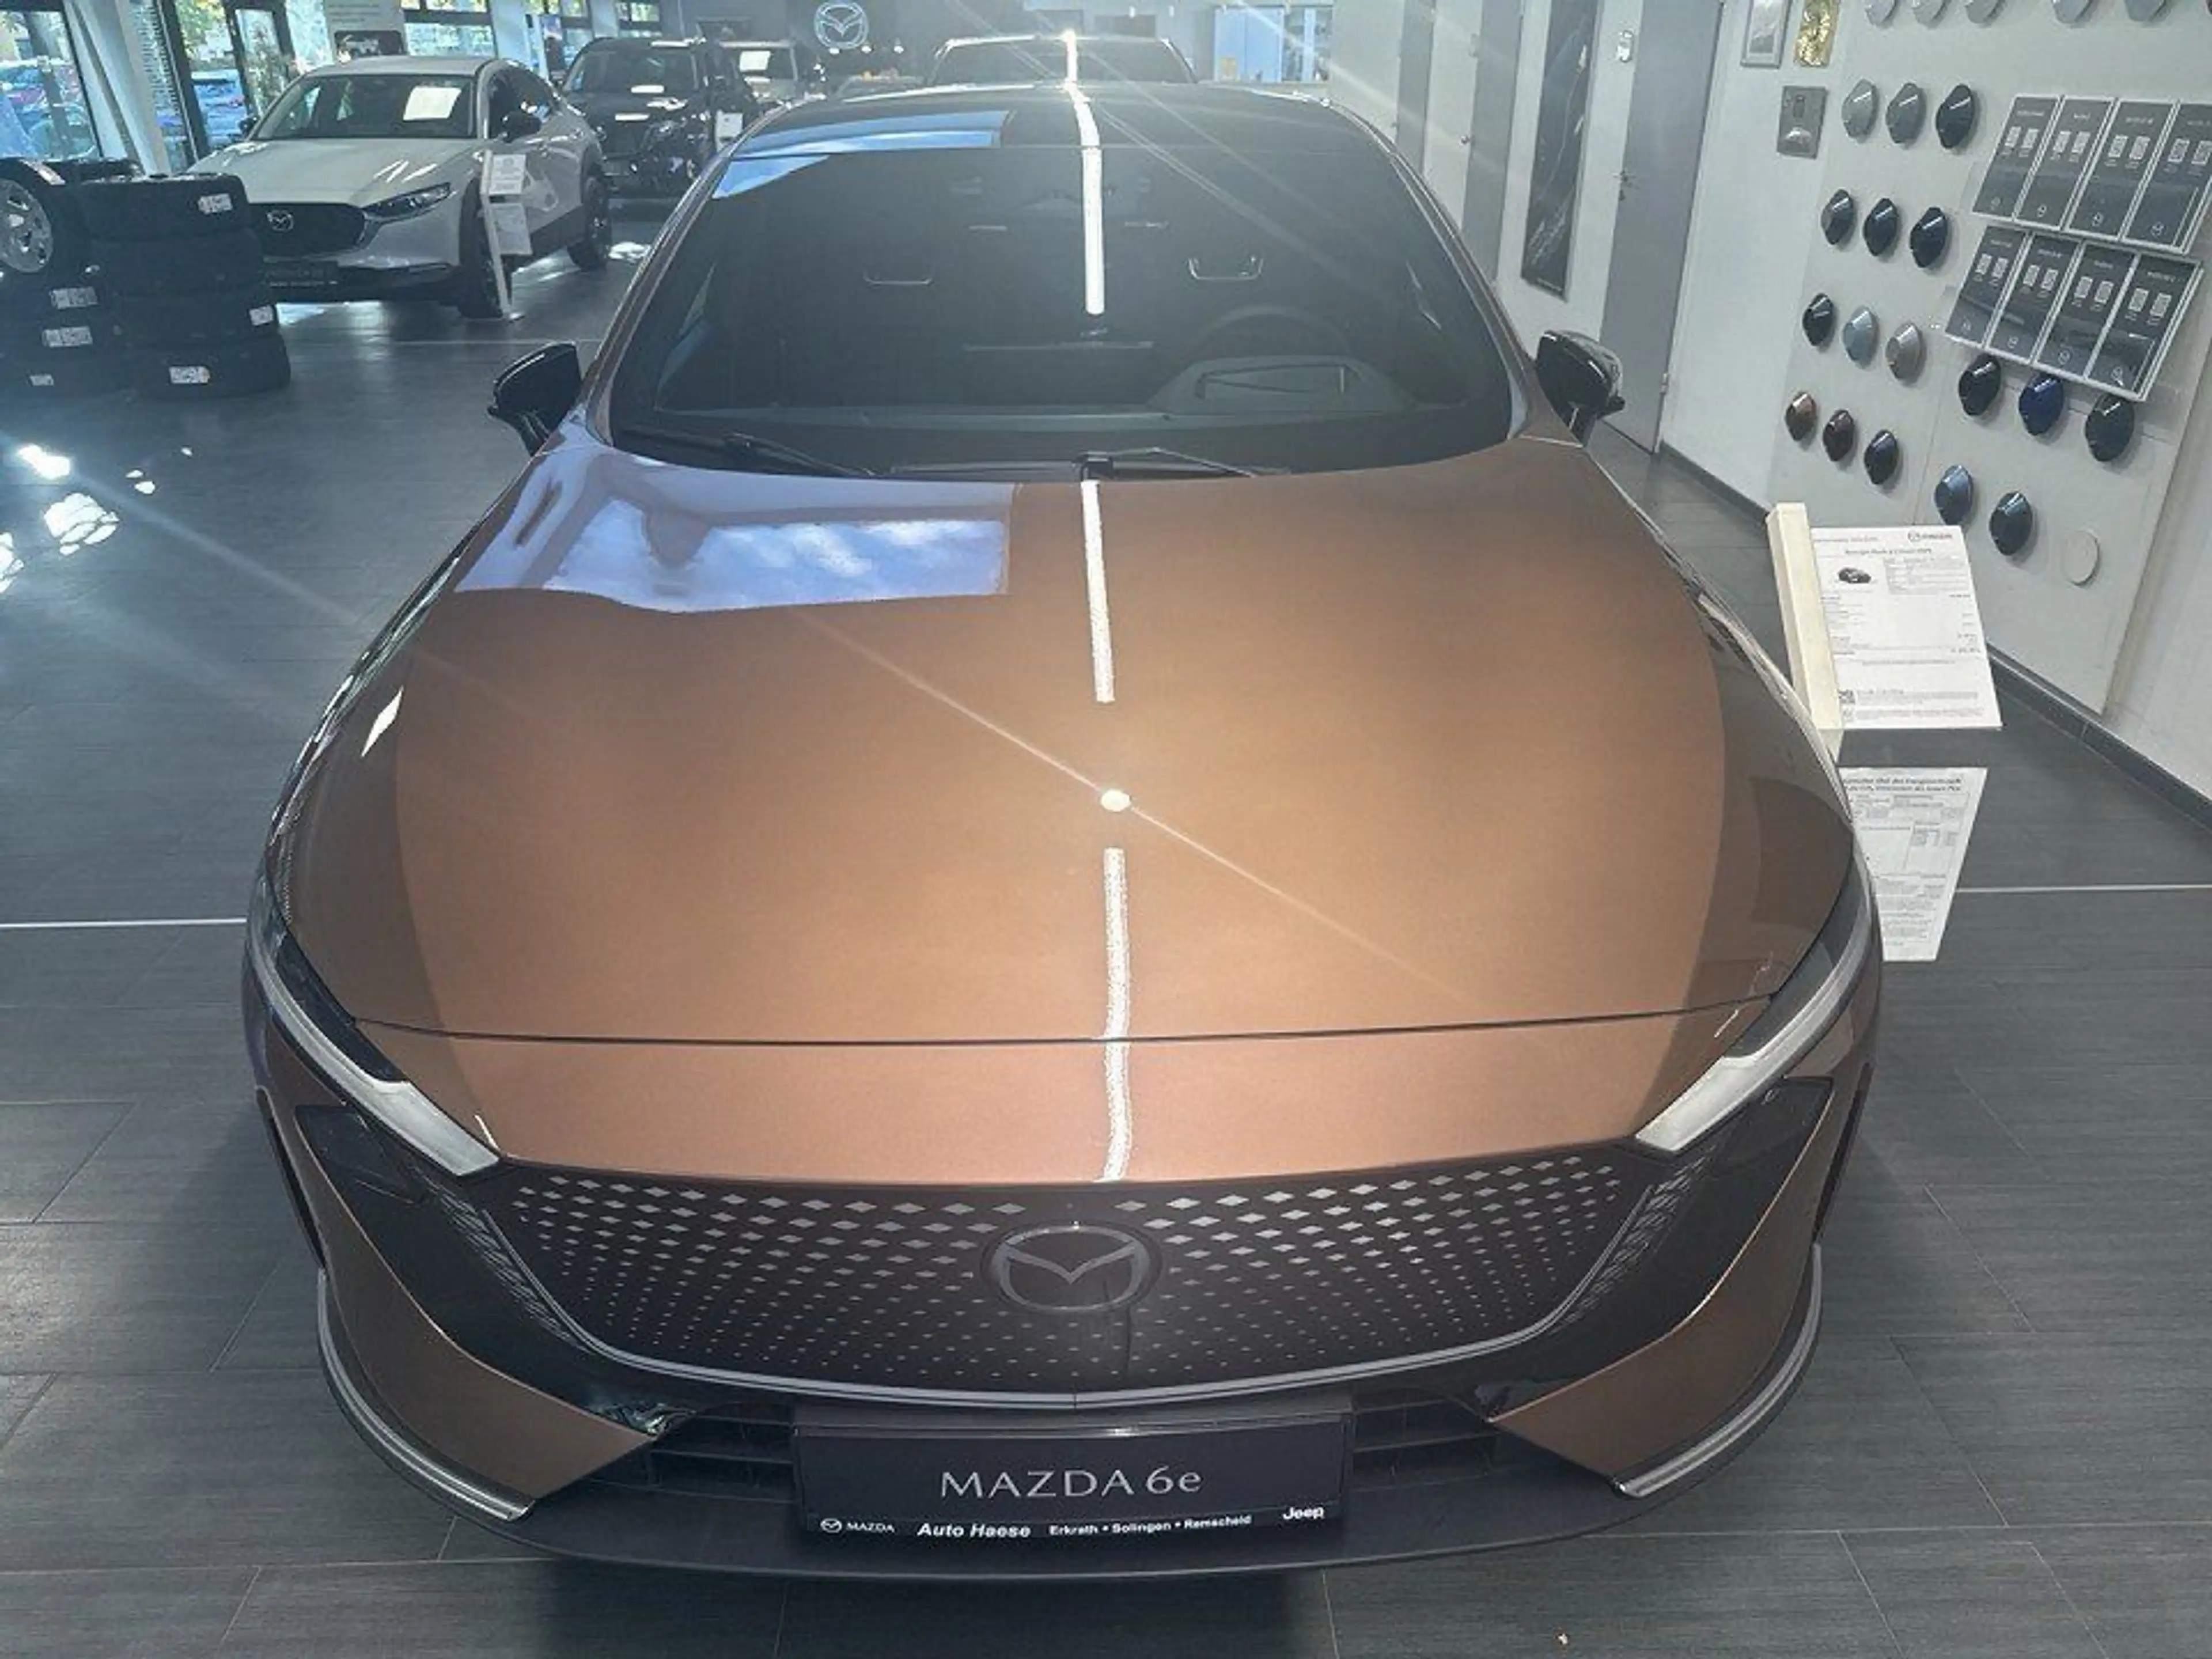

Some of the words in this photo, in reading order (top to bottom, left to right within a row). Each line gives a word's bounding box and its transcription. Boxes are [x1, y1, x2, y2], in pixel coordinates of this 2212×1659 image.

[940, 1469, 1134, 1498] MAZDA
[1145, 1465, 1205, 1495] 6e
[1282, 1506, 1325, 1521] Jeep
[847, 1522, 895, 1533] MAZDA
[917, 1522, 964, 1537] Auto
[969, 1522, 1031, 1538] Haese
[1049, 1525, 1098, 1535] Erkrath
[1112, 1521, 1172, 1535] Solingen
[1184, 1514, 1252, 1529] Remscheid
